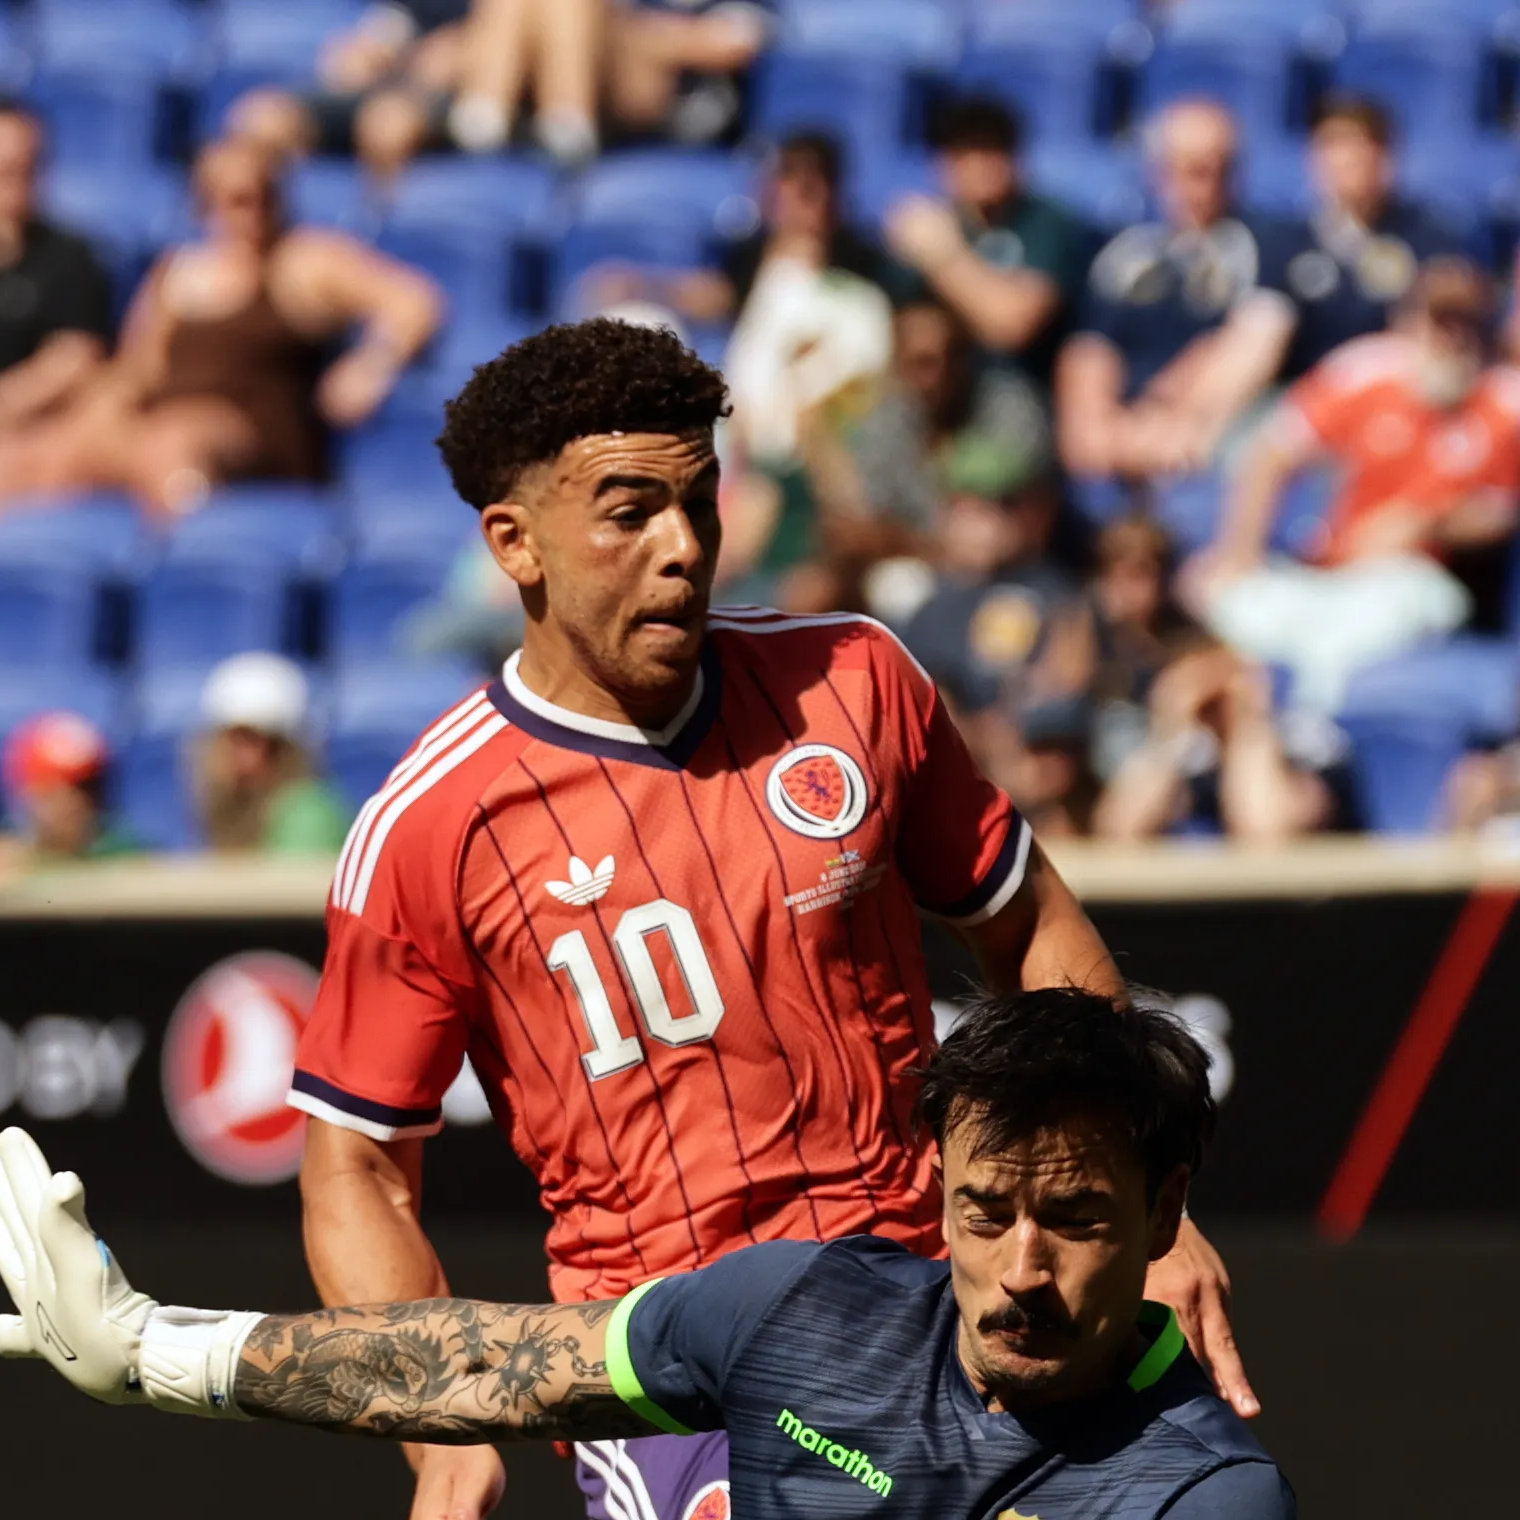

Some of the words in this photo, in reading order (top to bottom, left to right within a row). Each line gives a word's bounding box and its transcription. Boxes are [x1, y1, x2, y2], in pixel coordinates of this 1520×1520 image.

[547, 899, 725, 1082] 10
[19, 1015, 143, 1118] BY
[776, 1408, 894, 1498] marathon
